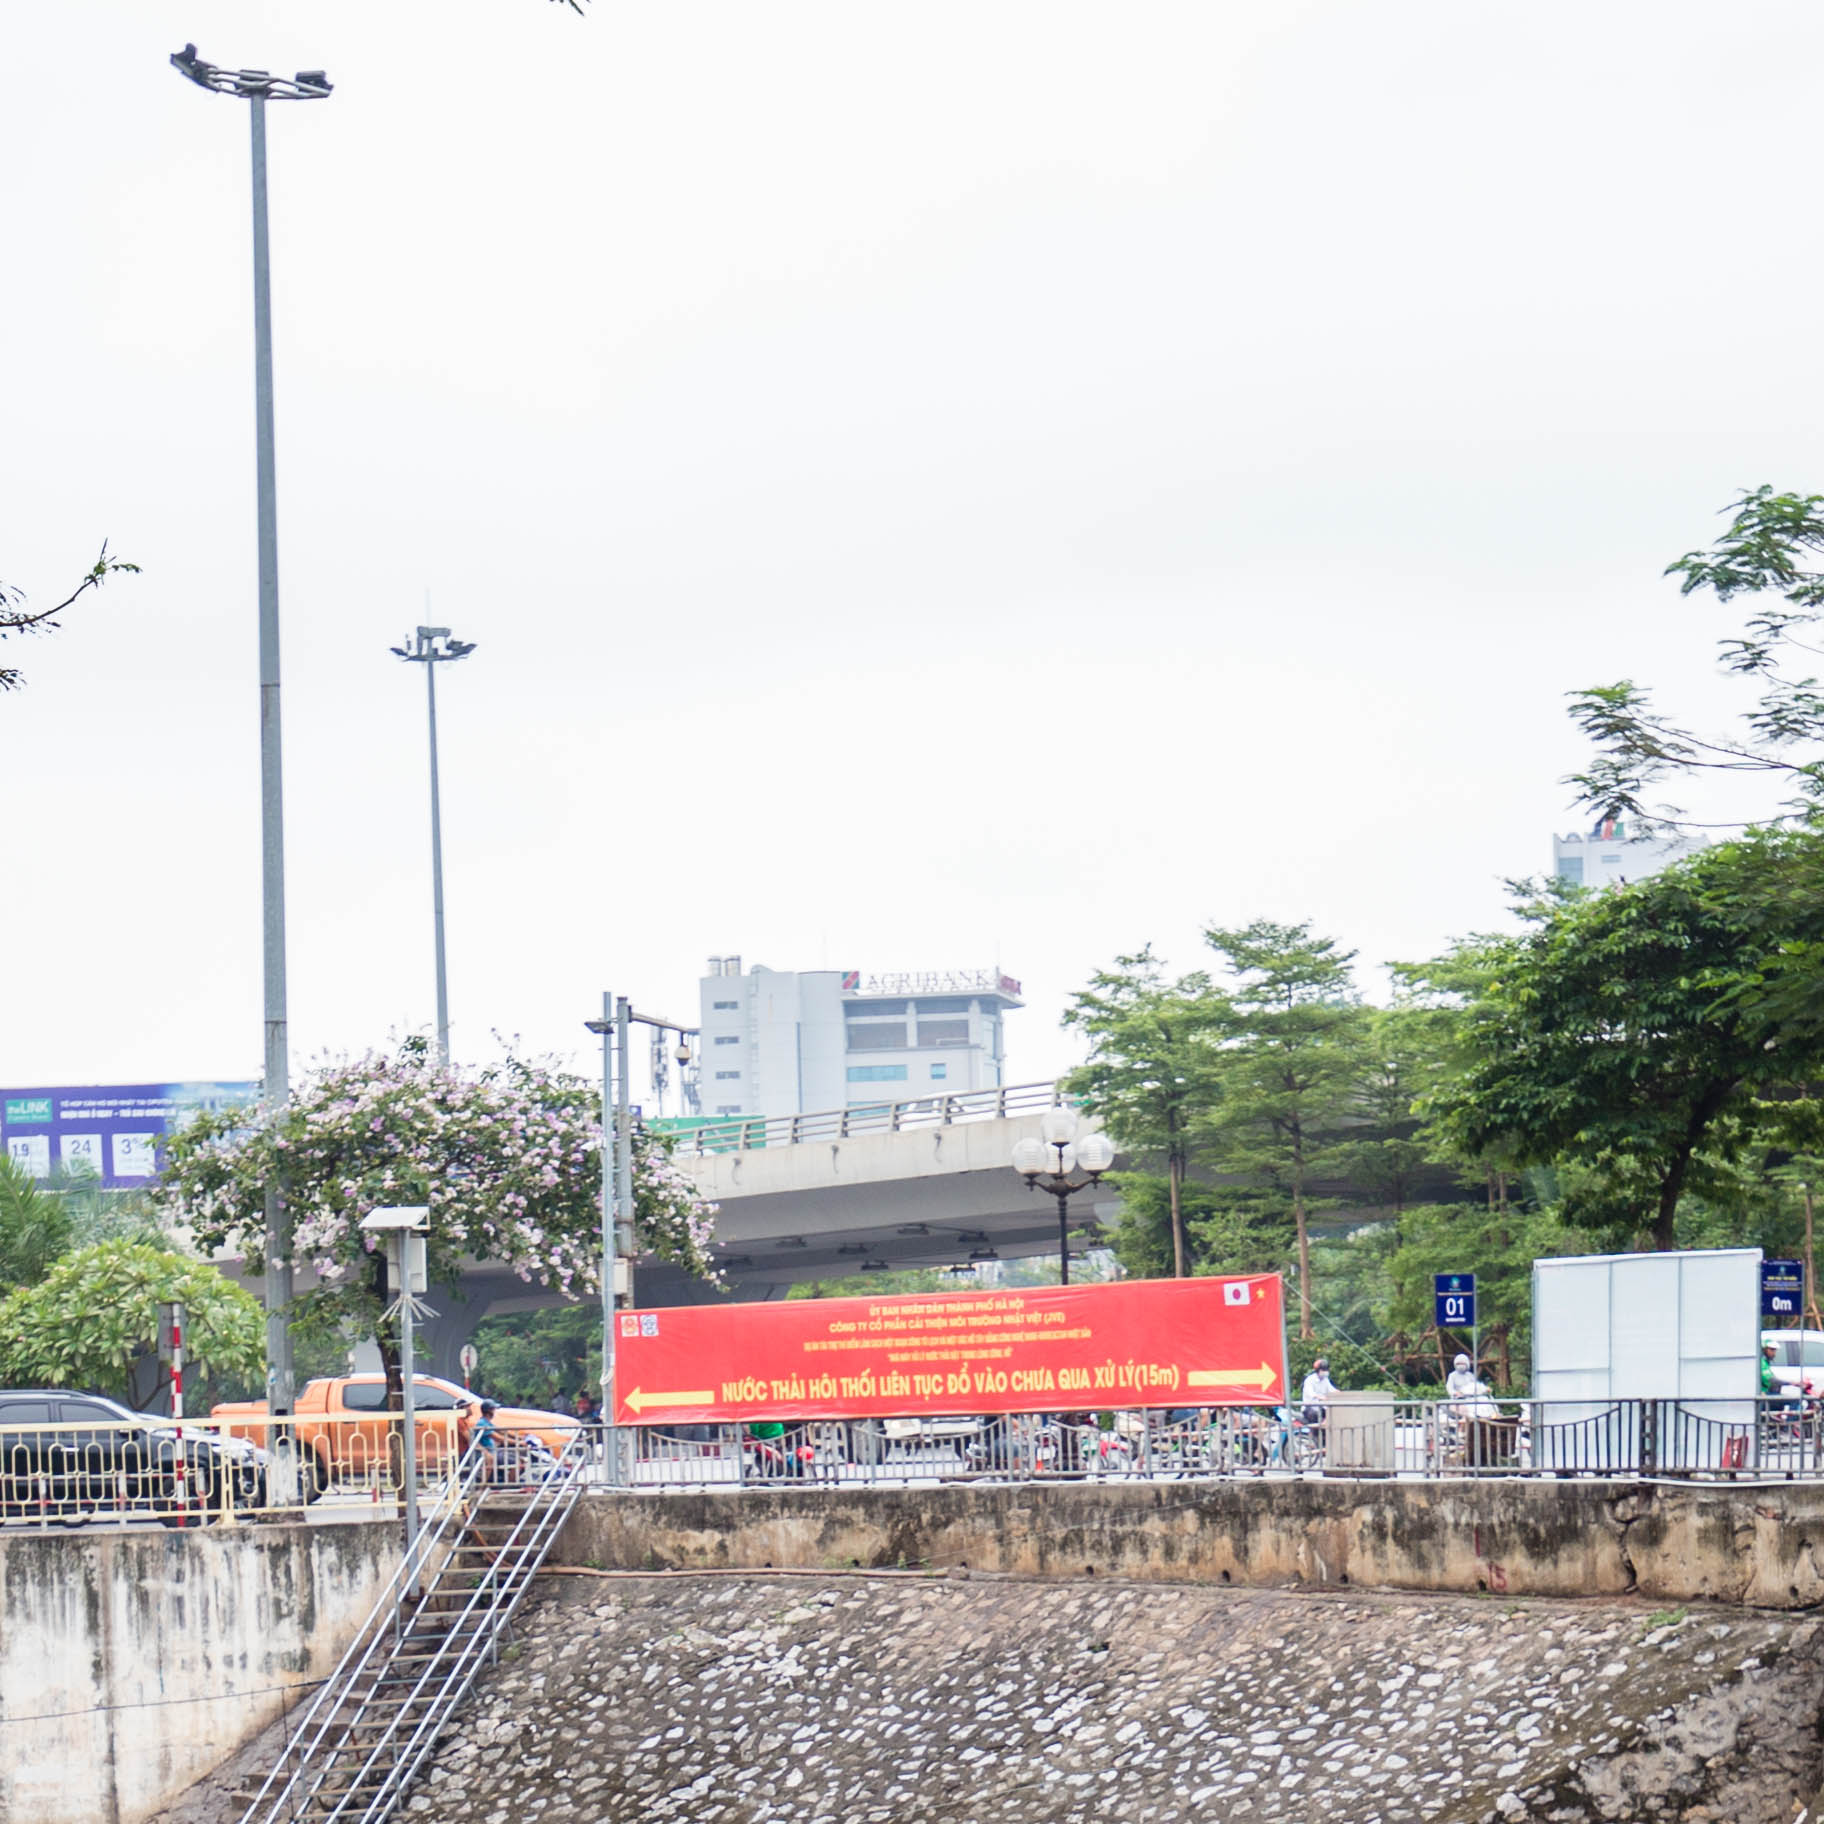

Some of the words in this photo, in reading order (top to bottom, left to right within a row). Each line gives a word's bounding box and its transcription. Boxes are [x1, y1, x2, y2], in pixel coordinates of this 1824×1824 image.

[1445, 1297, 1465, 1316] 01
[1771, 1296, 1793, 1311] 0m
[721, 1375, 768, 1403] NƯỚC
[770, 1372, 805, 1400] THẢI
[809, 1373, 837, 1399] HÔI
[840, 1368, 876, 1398] THỐI
[879, 1370, 911, 1397] LIÊN
[913, 1374, 944, 1401] TỤC
[947, 1362, 971, 1395] ĐỔ
[974, 1367, 1008, 1393] VÀO
[1011, 1367, 1055, 1392] CHƯA
[1058, 1367, 1091, 1391] QUA
[1094, 1358, 1116, 1388] XỬ
